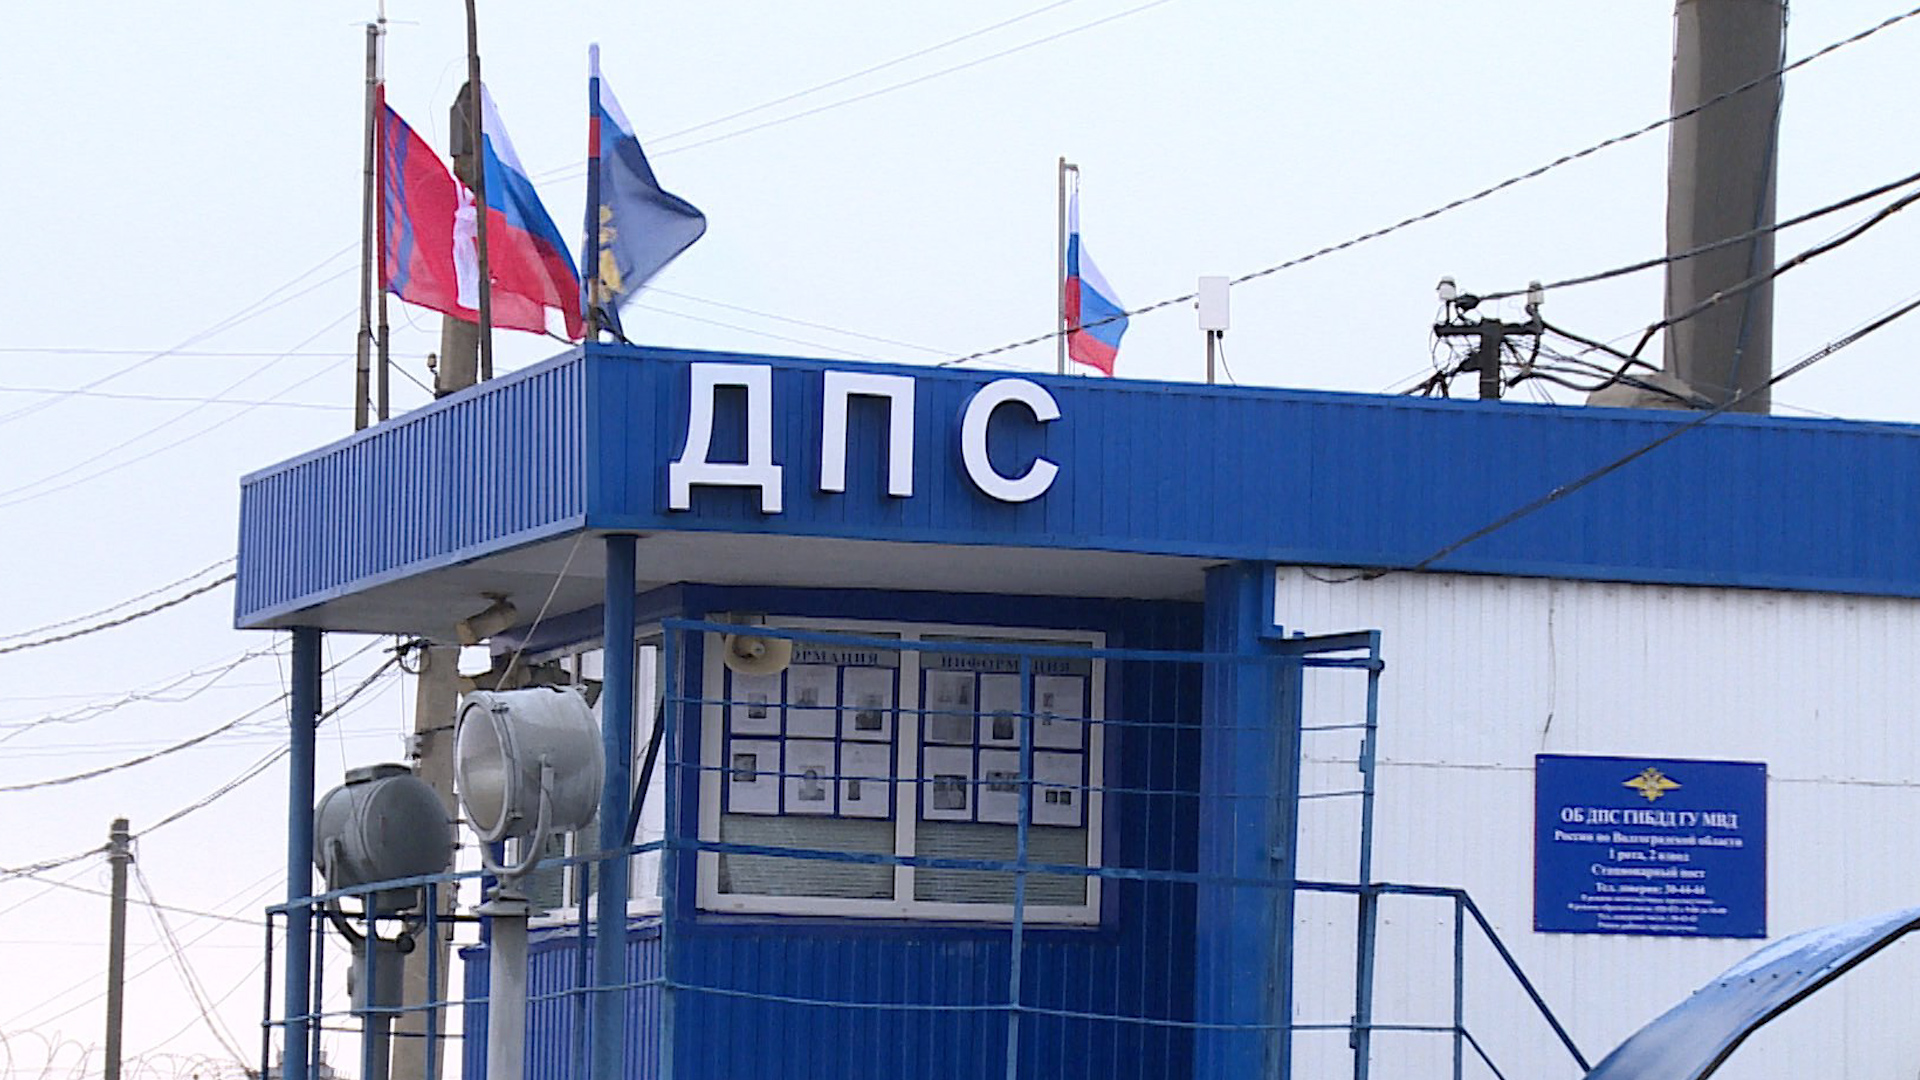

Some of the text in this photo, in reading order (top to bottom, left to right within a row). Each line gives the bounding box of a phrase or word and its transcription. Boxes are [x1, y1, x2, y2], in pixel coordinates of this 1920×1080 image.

[669, 362, 1061, 514] ДПС
[791, 649, 878, 665] ОРМАЦИЯ
[940, 655, 1070, 673] ИНФОРМЦИЯ
[1561, 807, 1738, 829] ОБ ДПС ГИБДД ГУ МВД
[1554, 829, 1594, 842] России
